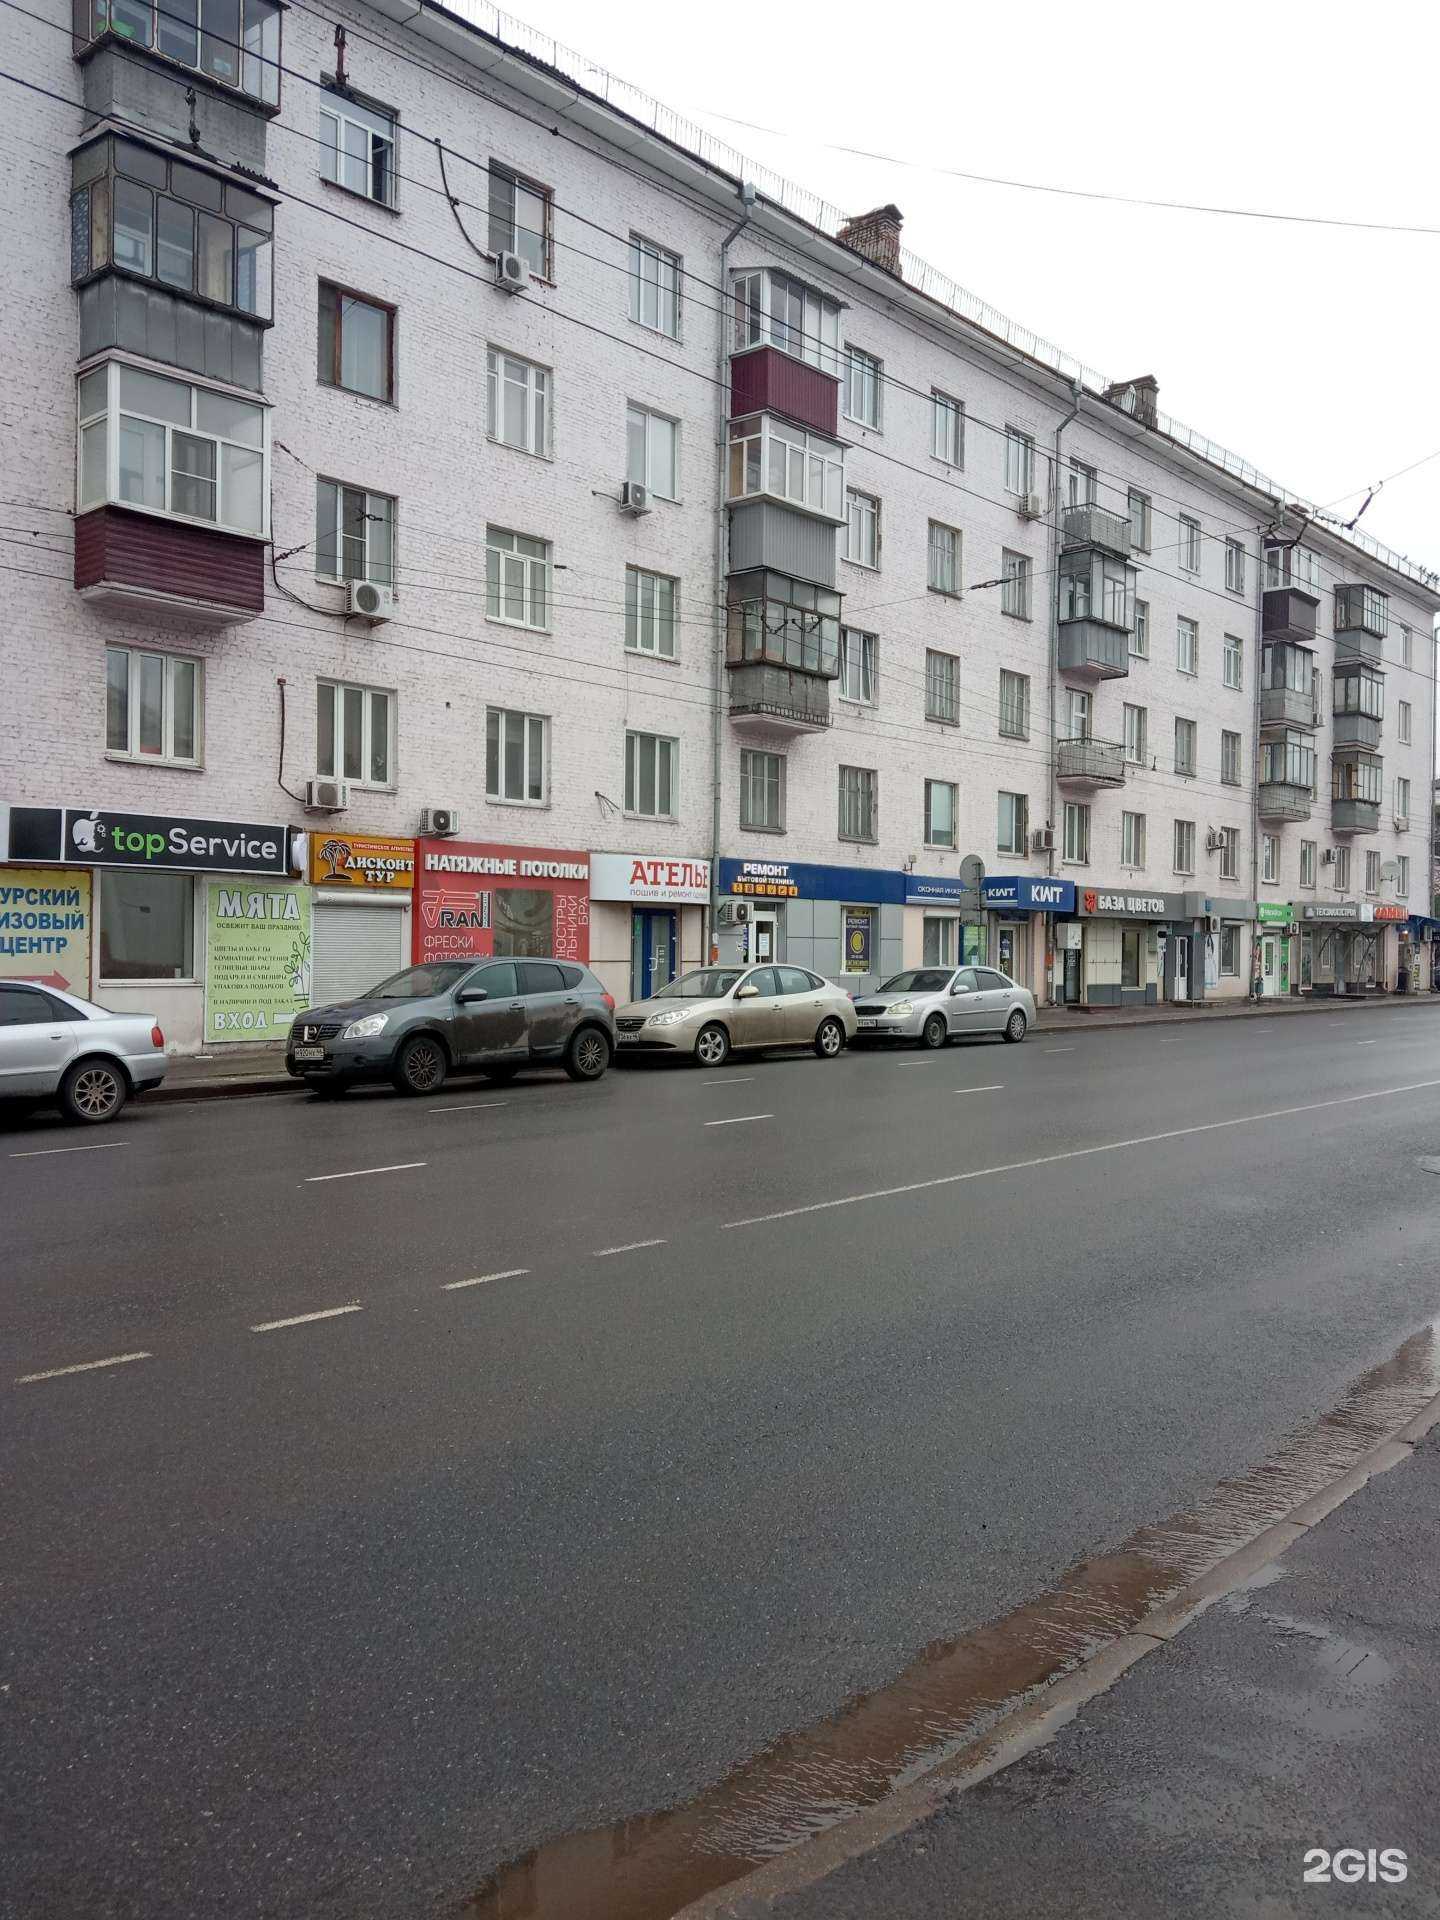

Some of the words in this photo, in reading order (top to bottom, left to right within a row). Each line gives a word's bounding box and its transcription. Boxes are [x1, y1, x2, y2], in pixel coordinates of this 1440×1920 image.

[345, 856, 414, 871] ДИСКОНТ
[425, 854, 517, 876] НАТЯЖНЫЕ
[520, 860, 588, 880] ПОТОЛКИ
[743, 862, 789, 877] РЕМОНТ
[365, 870, 395, 883] ТУР
[629, 861, 708, 889] АТЕЛЬЕ
[737, 875, 768, 884] БЫТОВОЙ
[768, 877, 795, 885] ТЕХНИКИ
[0, 886, 80, 906] УРСКИЙ
[630, 889, 659, 897] пошив
[216, 889, 301, 920] МЯТА
[578, 896, 589, 925] БРА
[1098, 896, 1126, 911] БАЗА
[1127, 898, 1165, 914] ЦВЕТОВ
[0, 910, 84, 930] ИЗОВЫЙ
[567, 895, 578, 960] ЛЬНИКИ
[0, 936, 68, 956] ЦЕНТР
[424, 936, 474, 949] ФРЕСКИ
[214, 1011, 268, 1030] ВХОД
